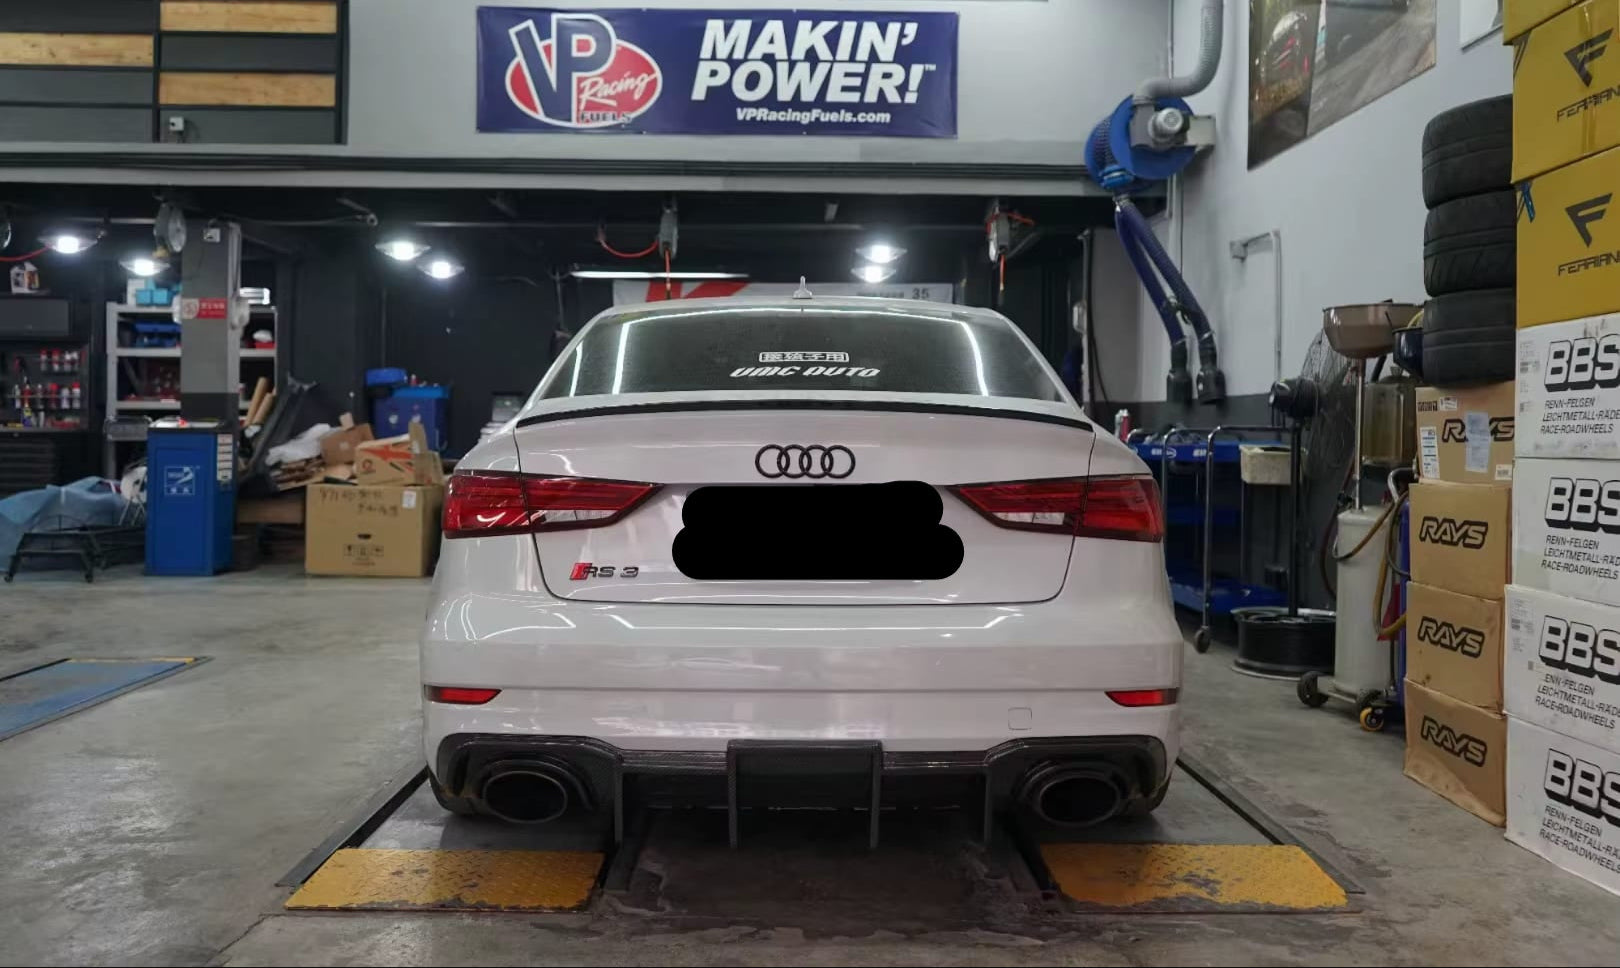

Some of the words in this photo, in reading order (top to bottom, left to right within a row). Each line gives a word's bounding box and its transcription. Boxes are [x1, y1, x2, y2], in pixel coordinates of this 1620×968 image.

[700, 19, 918, 61] MAKIN’
[508, 13, 617, 122] VP
[580, 71, 658, 110] Racing
[580, 111, 632, 123] FUELS
[736, 107, 891, 124] VPRacingFuels.com
[912, 287, 930, 299] 35
[802, 366, 881, 377] AUTO
[1544, 334, 1620, 392] BBS
[1544, 397, 1596, 409] RENN-FELGEN
[1540, 423, 1614, 434] RACE-ROADWHEELS
[1544, 477, 1620, 535] BBS
[1419, 516, 1489, 549] RAYS
[1546, 535, 1600, 549] RENN-FELGEN
[583, 566, 616, 578] RS
[620, 566, 639, 578] 3
[1541, 559, 1619, 580] RACE-ROADWHEELS
[1417, 616, 1485, 659] RAYS
[1539, 615, 1620, 686] BBS
[1544, 673, 1595, 696] ENN-FELGEN
[1536, 695, 1616, 729] RACE-ROADWHEELS
[1420, 715, 1487, 767] RAYS
[1544, 748, 1620, 828] BBS
[1545, 805, 1602, 837] RENN-FELGEN
[1540, 828, 1620, 873] RACE-ROADWHEELS
